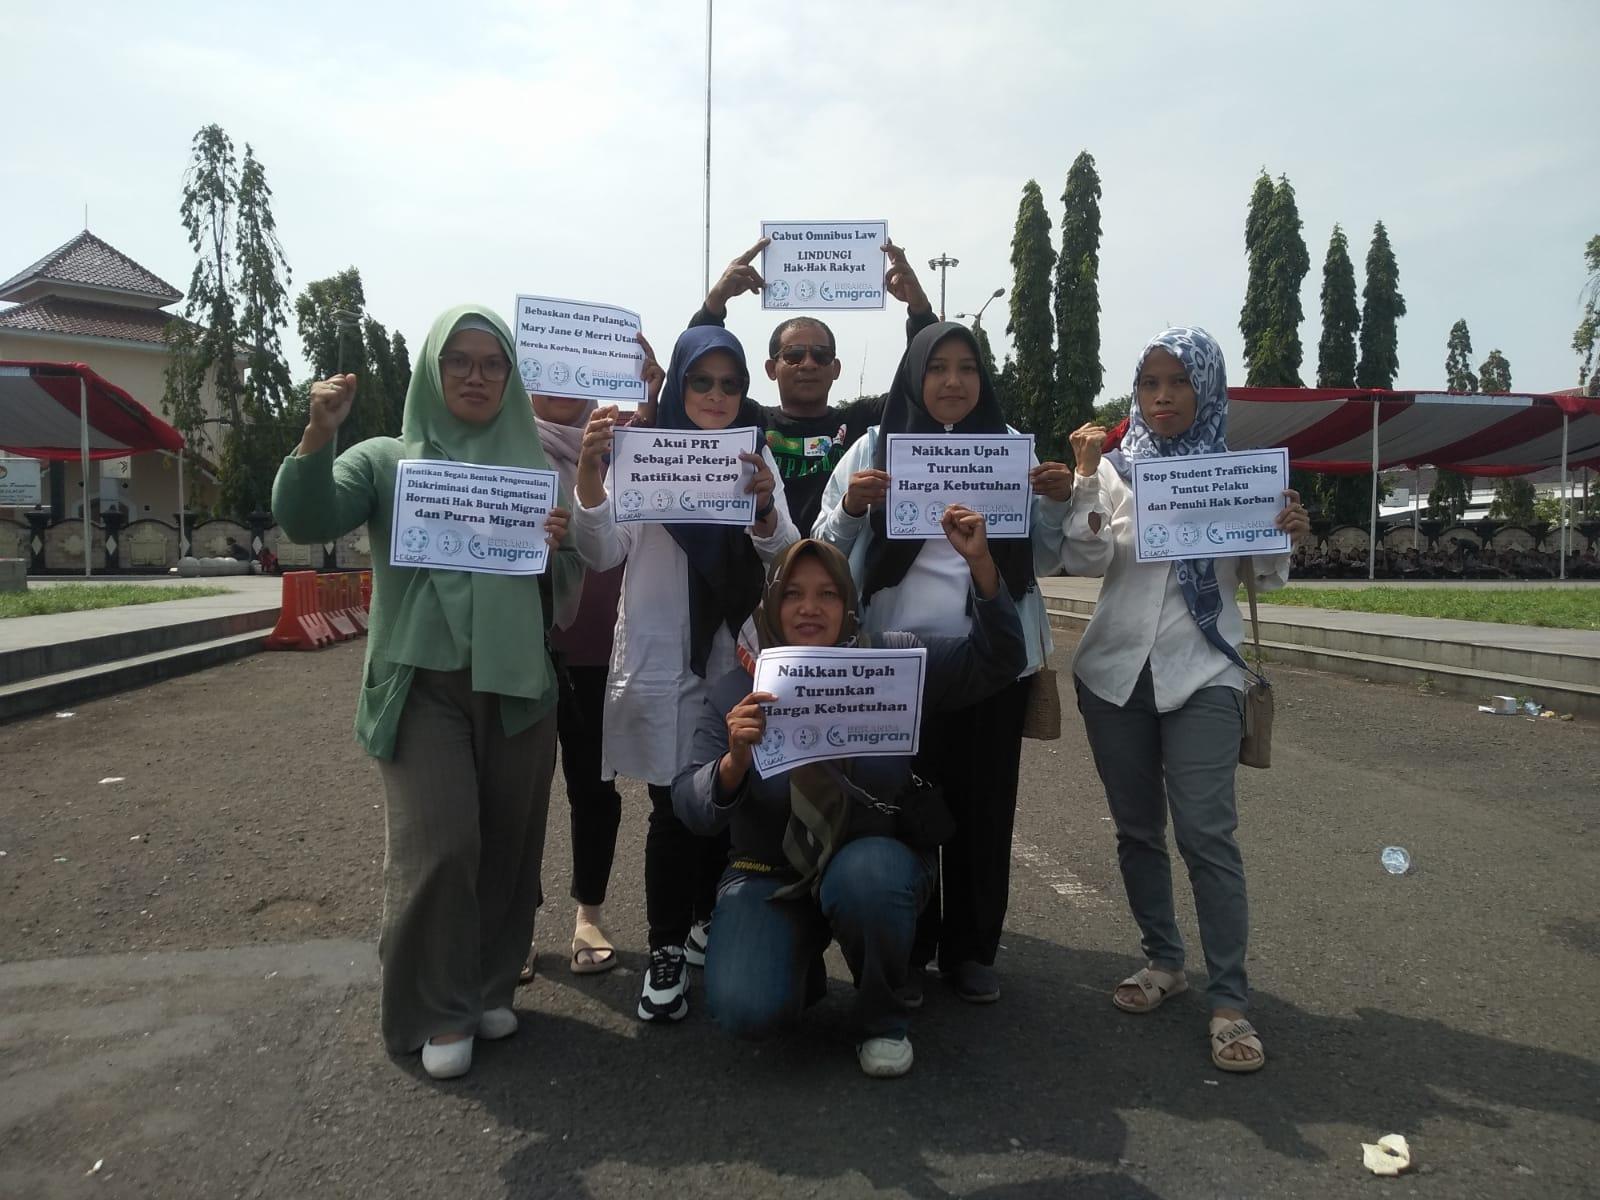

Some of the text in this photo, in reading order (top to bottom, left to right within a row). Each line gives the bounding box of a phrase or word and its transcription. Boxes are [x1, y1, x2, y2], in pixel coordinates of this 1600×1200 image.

[772, 231, 877, 240] Cabut Omnibus Law
[798, 251, 851, 260] LINDUNGI
[783, 263, 865, 273] Hak-Hak Rakyat
[835, 289, 881, 301] migran
[524, 306, 637, 329] Bebaskan dan Pulangkan
[520, 323, 546, 334] Mary
[548, 326, 572, 336] Jane
[585, 330, 612, 341] Merri
[550, 344, 581, 354] Korban,
[582, 348, 608, 357] Bukan
[609, 351, 642, 360] Kriminal
[592, 378, 642, 390] migran
[652, 438, 720, 449] Akui PRT
[912, 446, 1009, 458] Naikkan Upah
[633, 453, 737, 466] Sebagai Pekerja
[927, 463, 993, 473] Turunkan
[1143, 464, 1278, 482] Stop Student Trafficking
[405, 468, 550, 488] Hentikan Segala Bentuk Pengecualian,
[631, 472, 702, 482] Ratifikasi
[408, 480, 547, 501] Diskriminasi dan Stigmatisasi
[899, 480, 1020, 492] Harga Kebutuhan
[1171, 481, 1249, 495] Tuntut Pelaku
[406, 493, 546, 515] Hormati Hak Buruh Migran
[697, 500, 749, 511] migran
[1148, 496, 1274, 511] dan Penuhi Hak Korban
[415, 509, 535, 528] dan Purna Migran
[983, 512, 1022, 525] igran
[1226, 527, 1284, 542] migran
[487, 547, 542, 562] migran
[778, 665, 895, 679] Naikkan Upah
[795, 685, 875, 698] Turunkan
[763, 702, 908, 717] Harga Kebutuhan
[848, 731, 910, 744] migran
